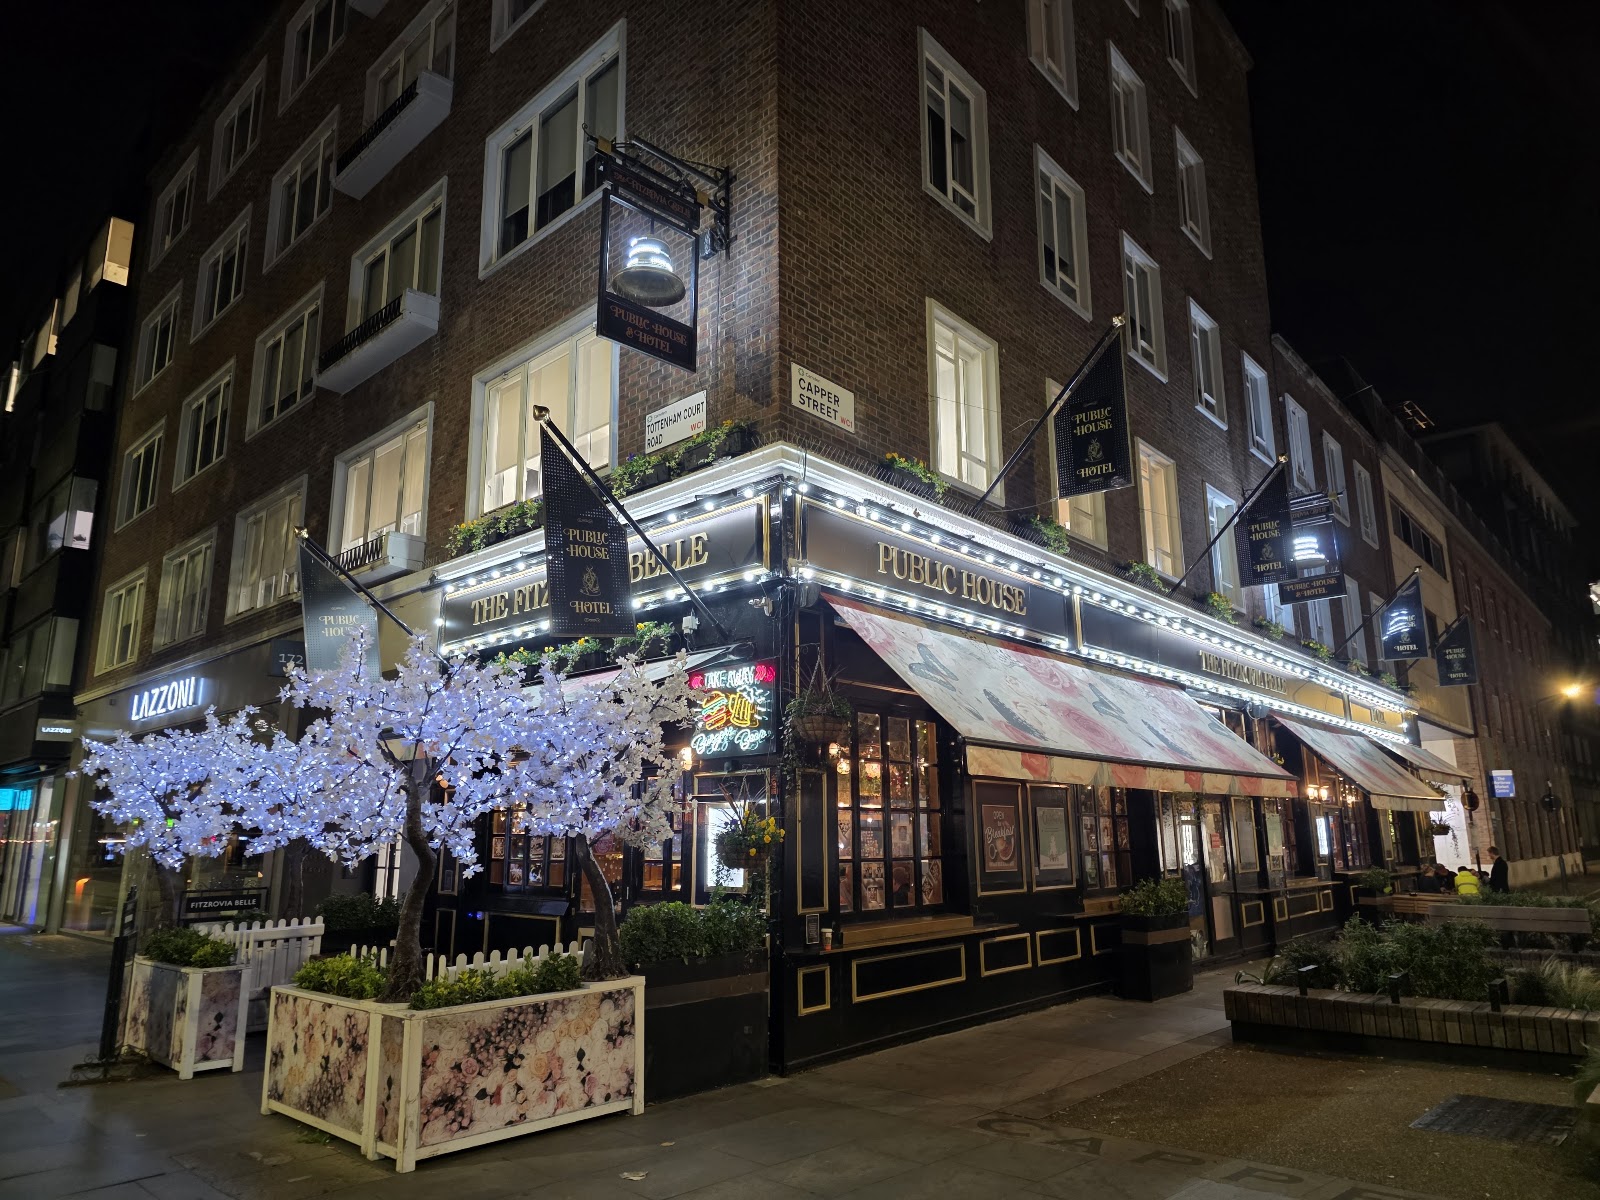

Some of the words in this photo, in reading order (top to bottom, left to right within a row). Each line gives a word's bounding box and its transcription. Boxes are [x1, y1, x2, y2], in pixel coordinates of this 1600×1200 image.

[610, 305, 650, 331] PUBLIC
[652, 322, 688, 347] HOUSE
[625, 326, 635, 340] &
[634, 330, 673, 355] HOTEL
[798, 377, 840, 408] CAPPER
[646, 410, 682, 435] TOTTENHAM
[683, 401, 705, 420] COURT
[798, 393, 839, 421] STREET
[840, 416, 853, 429] WC1
[1071, 406, 1112, 425] PUBLIC
[690, 420, 704, 432] WC1
[1073, 418, 1113, 437] HOUSE
[646, 433, 663, 450] ROAD
[1076, 462, 1116, 479] HOTEL
[1248, 520, 1281, 533] PUBLIC
[1250, 529, 1281, 541] HOUSE
[562, 527, 609, 546] PUBLIC
[566, 544, 610, 561] HOUSE
[1253, 561, 1285, 573] HOTEL
[471, 591, 509, 626] THE
[629, 531, 709, 584] BELLE
[877, 541, 957, 595] PUBLIC
[960, 569, 1027, 616] HOUSE
[1284, 583, 1310, 592] PUBLIC
[1311, 578, 1338, 587] HOUSE
[1300, 588, 1328, 597] HOTEL
[569, 599, 614, 615] HOTEL
[318, 614, 360, 626] PUBLIC
[321, 627, 353, 637] HOU
[1393, 644, 1419, 652] HOTEL
[279, 653, 304, 665] 172
[1199, 650, 1221, 675] THE
[704, 669, 727, 689] TAKE
[726, 666, 756, 688] AWAY
[131, 676, 197, 722] LAZZONI
[41, 726, 73, 734] LAZZONI
[190, 899, 233, 909] FITZROVIA
[234, 898, 257, 907] BELLE
